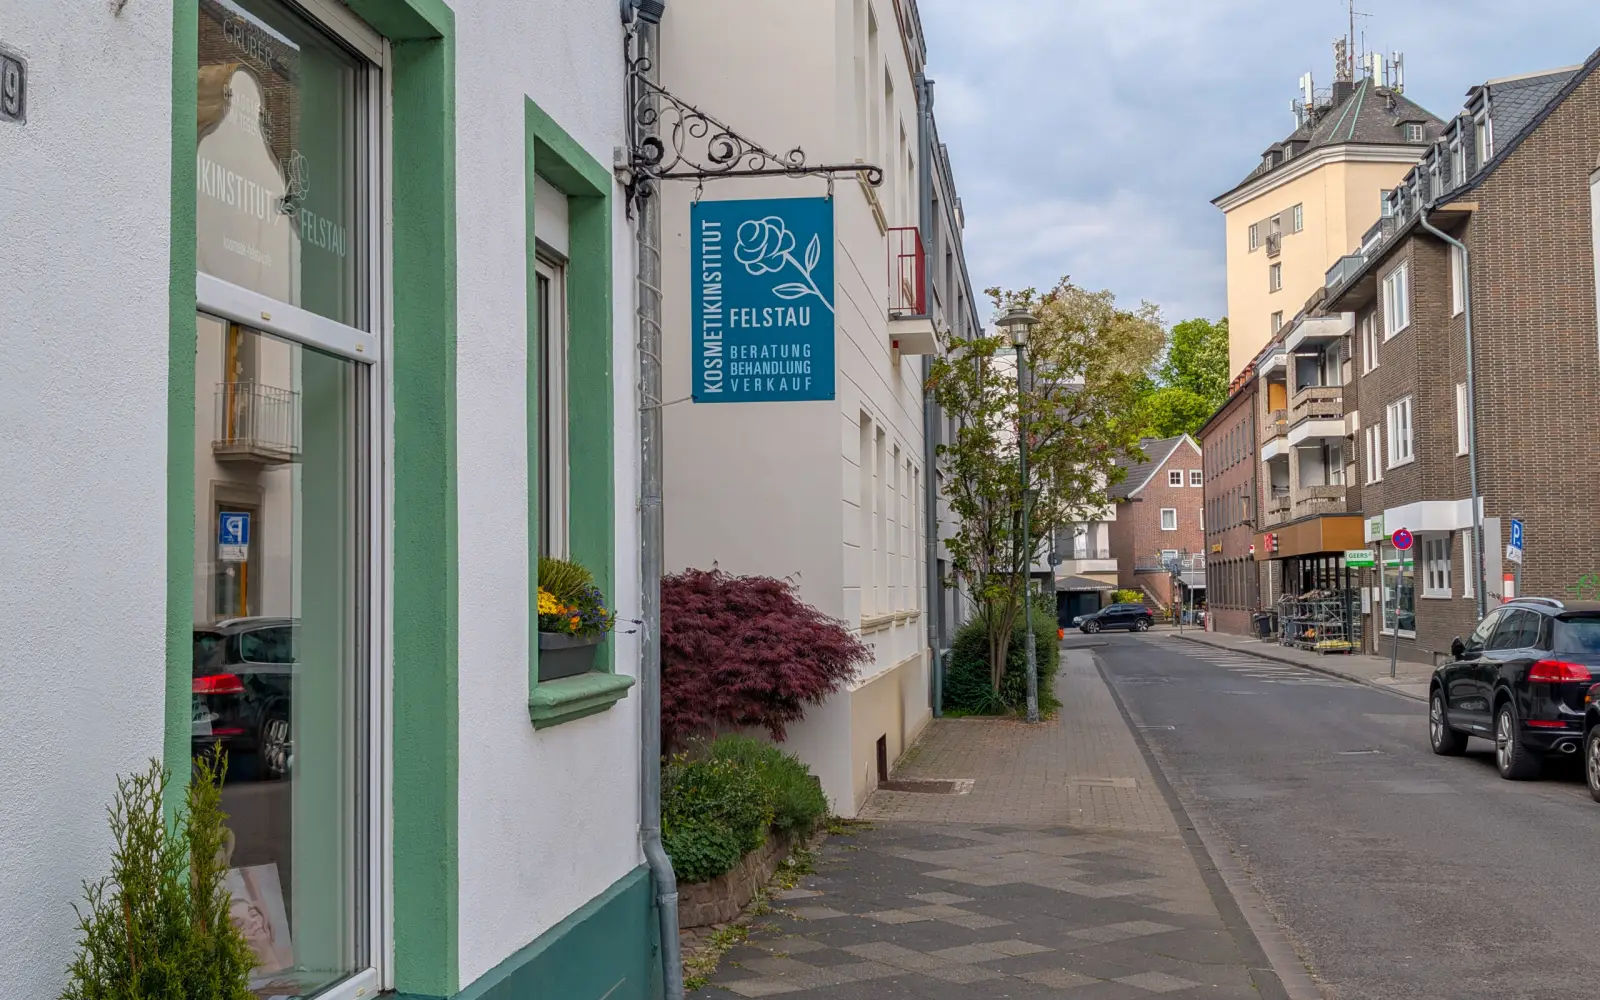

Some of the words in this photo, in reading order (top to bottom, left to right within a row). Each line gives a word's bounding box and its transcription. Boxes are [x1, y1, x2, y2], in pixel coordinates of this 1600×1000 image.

[223, 19, 272, 70] GRUBER
[5, 61, 19, 116] 9
[302, 207, 346, 258] FELSTAU
[702, 219, 723, 393] KOSMETIKINSTITUT
[730, 306, 811, 328] FELSTAU
[730, 344, 811, 359] BERATUNG
[730, 360, 811, 376] BEHANDLUNG
[730, 377, 812, 392] VERKAUF
[1513, 523, 1520, 545] P
